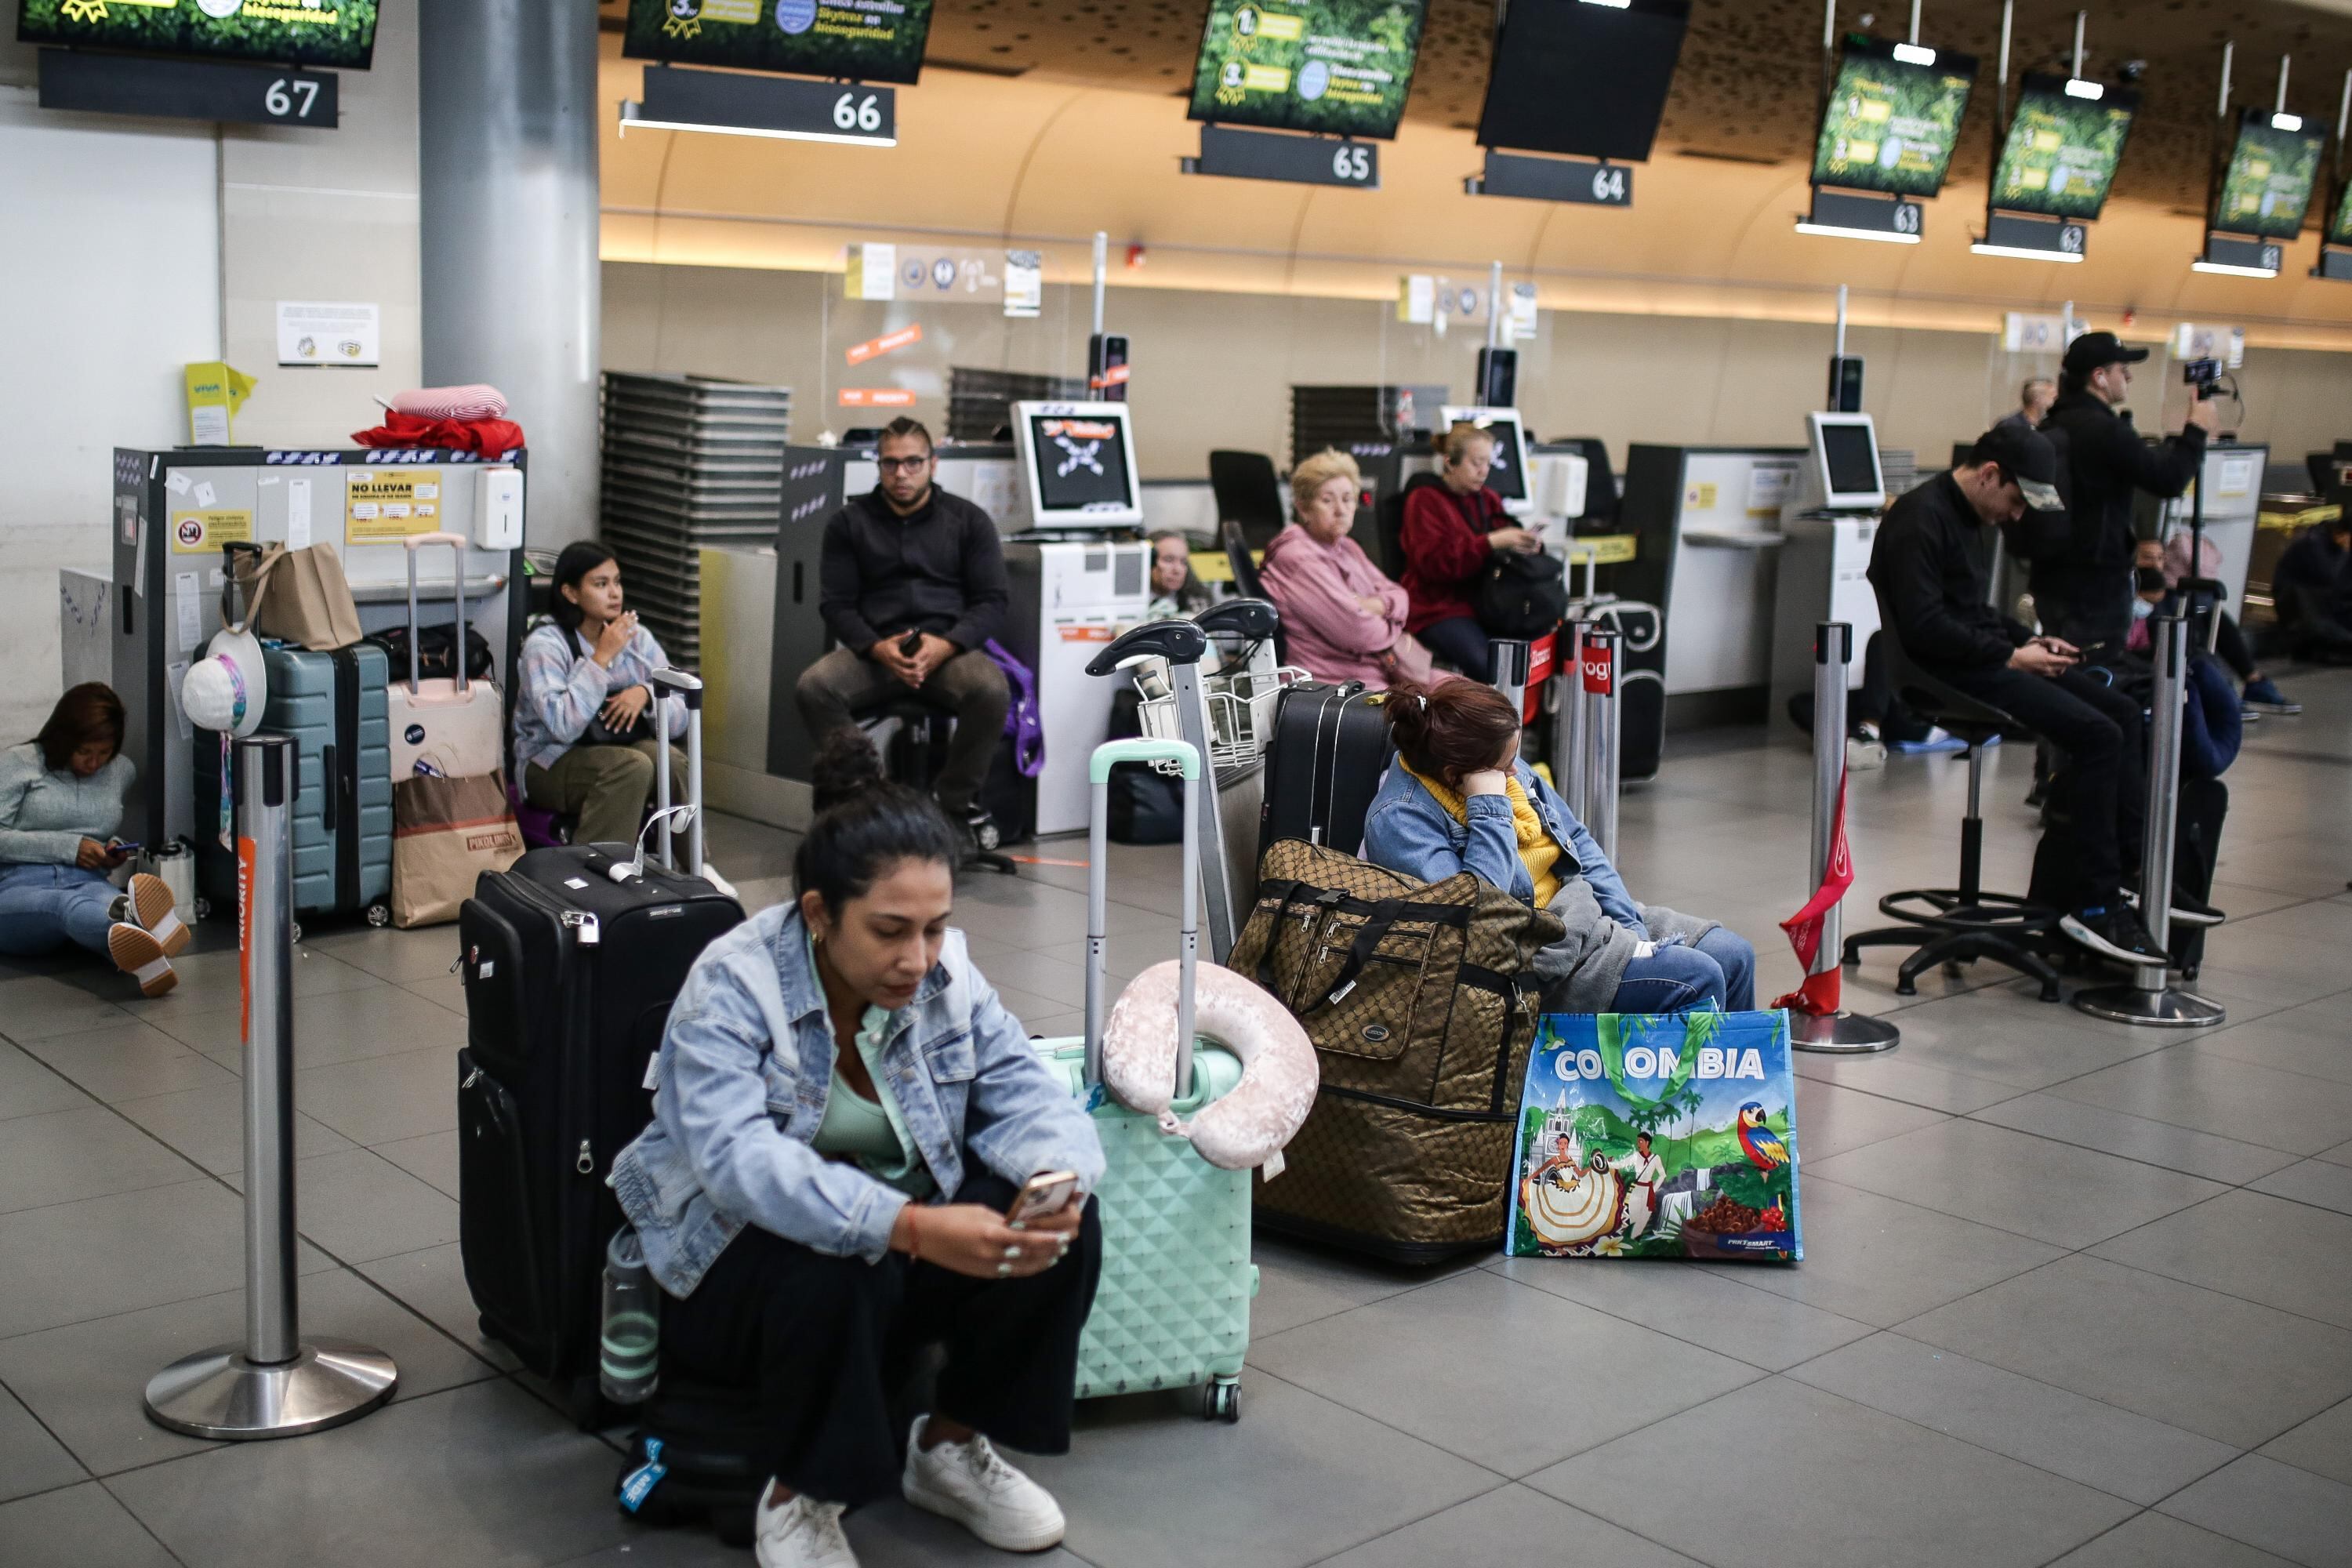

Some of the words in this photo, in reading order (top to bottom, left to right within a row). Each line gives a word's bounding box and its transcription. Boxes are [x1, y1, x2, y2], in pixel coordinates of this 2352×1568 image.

[265, 78, 320, 118] 67
[833, 92, 881, 132] 66
[1333, 146, 1369, 180] 65
[1592, 169, 1625, 201] 64
[1893, 204, 1918, 234] 63
[352, 484, 369, 492] NO
[372, 484, 412, 493] LLEVAR
